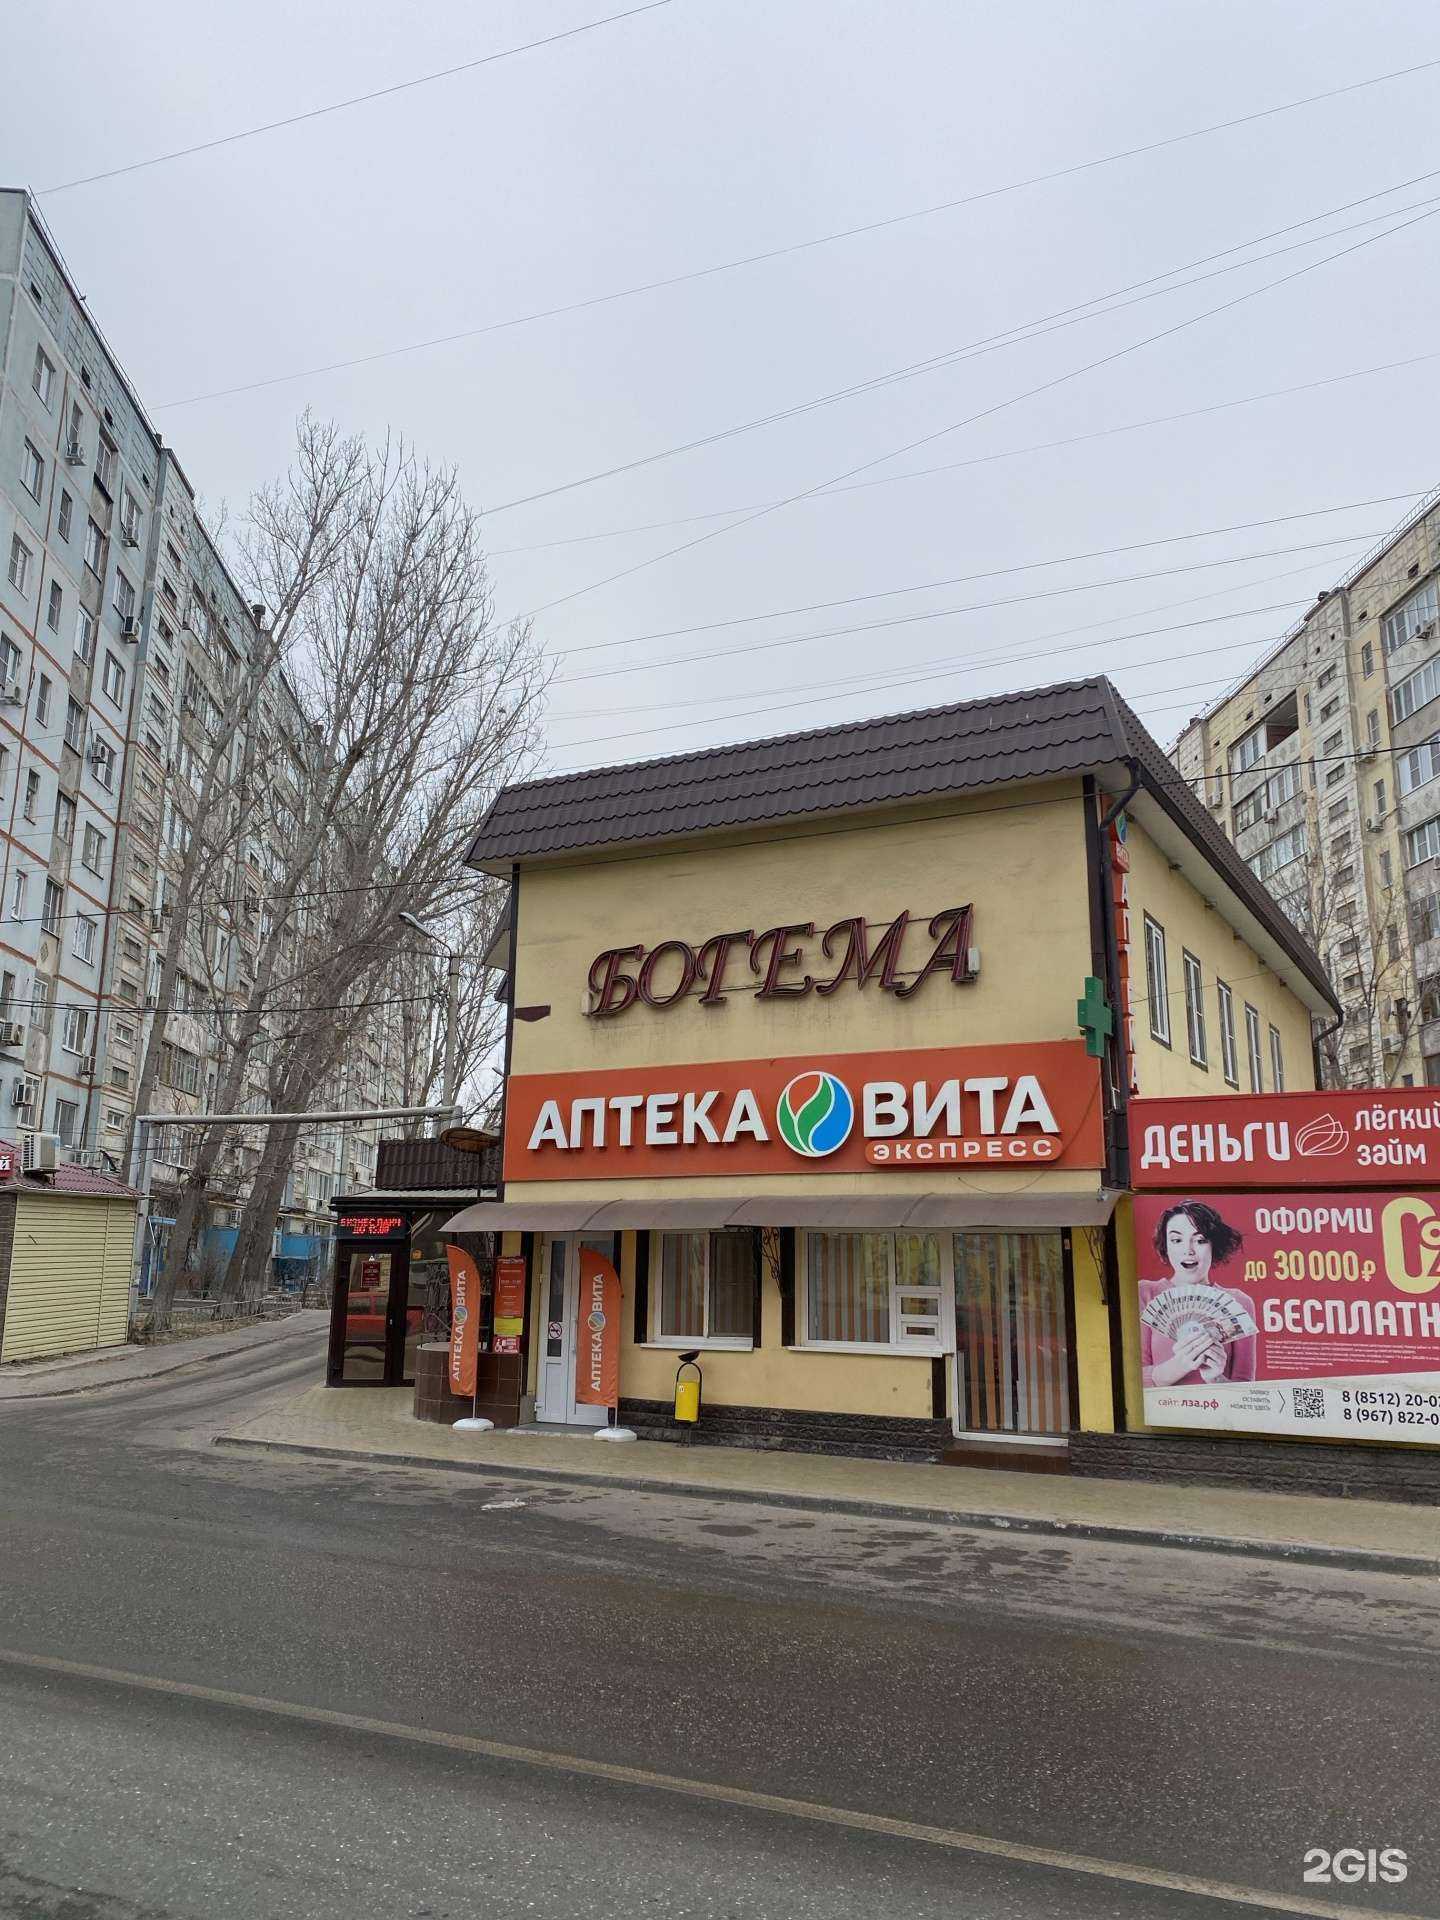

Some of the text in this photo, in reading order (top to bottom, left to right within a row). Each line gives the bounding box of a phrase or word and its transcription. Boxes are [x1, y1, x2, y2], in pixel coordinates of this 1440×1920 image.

[588, 902, 975, 1016] БОГЕМА
[527, 1075, 1060, 1150] АПТЕКА ВИТА
[873, 1138, 1053, 1161] ЭКСПРЕСС
[1141, 1121, 1291, 1169] ДЕНЬГИ
[1356, 1139, 1427, 1166] займ
[1255, 1207, 1374, 1234] ОФОРМИ
[1244, 1260, 1267, 1281] до
[452, 1269, 467, 1382] АПТЕКА ВИТА
[590, 1274, 604, 1392] АПТЕКА ВИТА
[1181, 1398, 1220, 1411] лза.рф
[1342, 1390, 1440, 1408] 8 (8512) 20-0
[1343, 1408, 1352, 1421] 8
[1356, 1408, 1393, 1425] (967)
